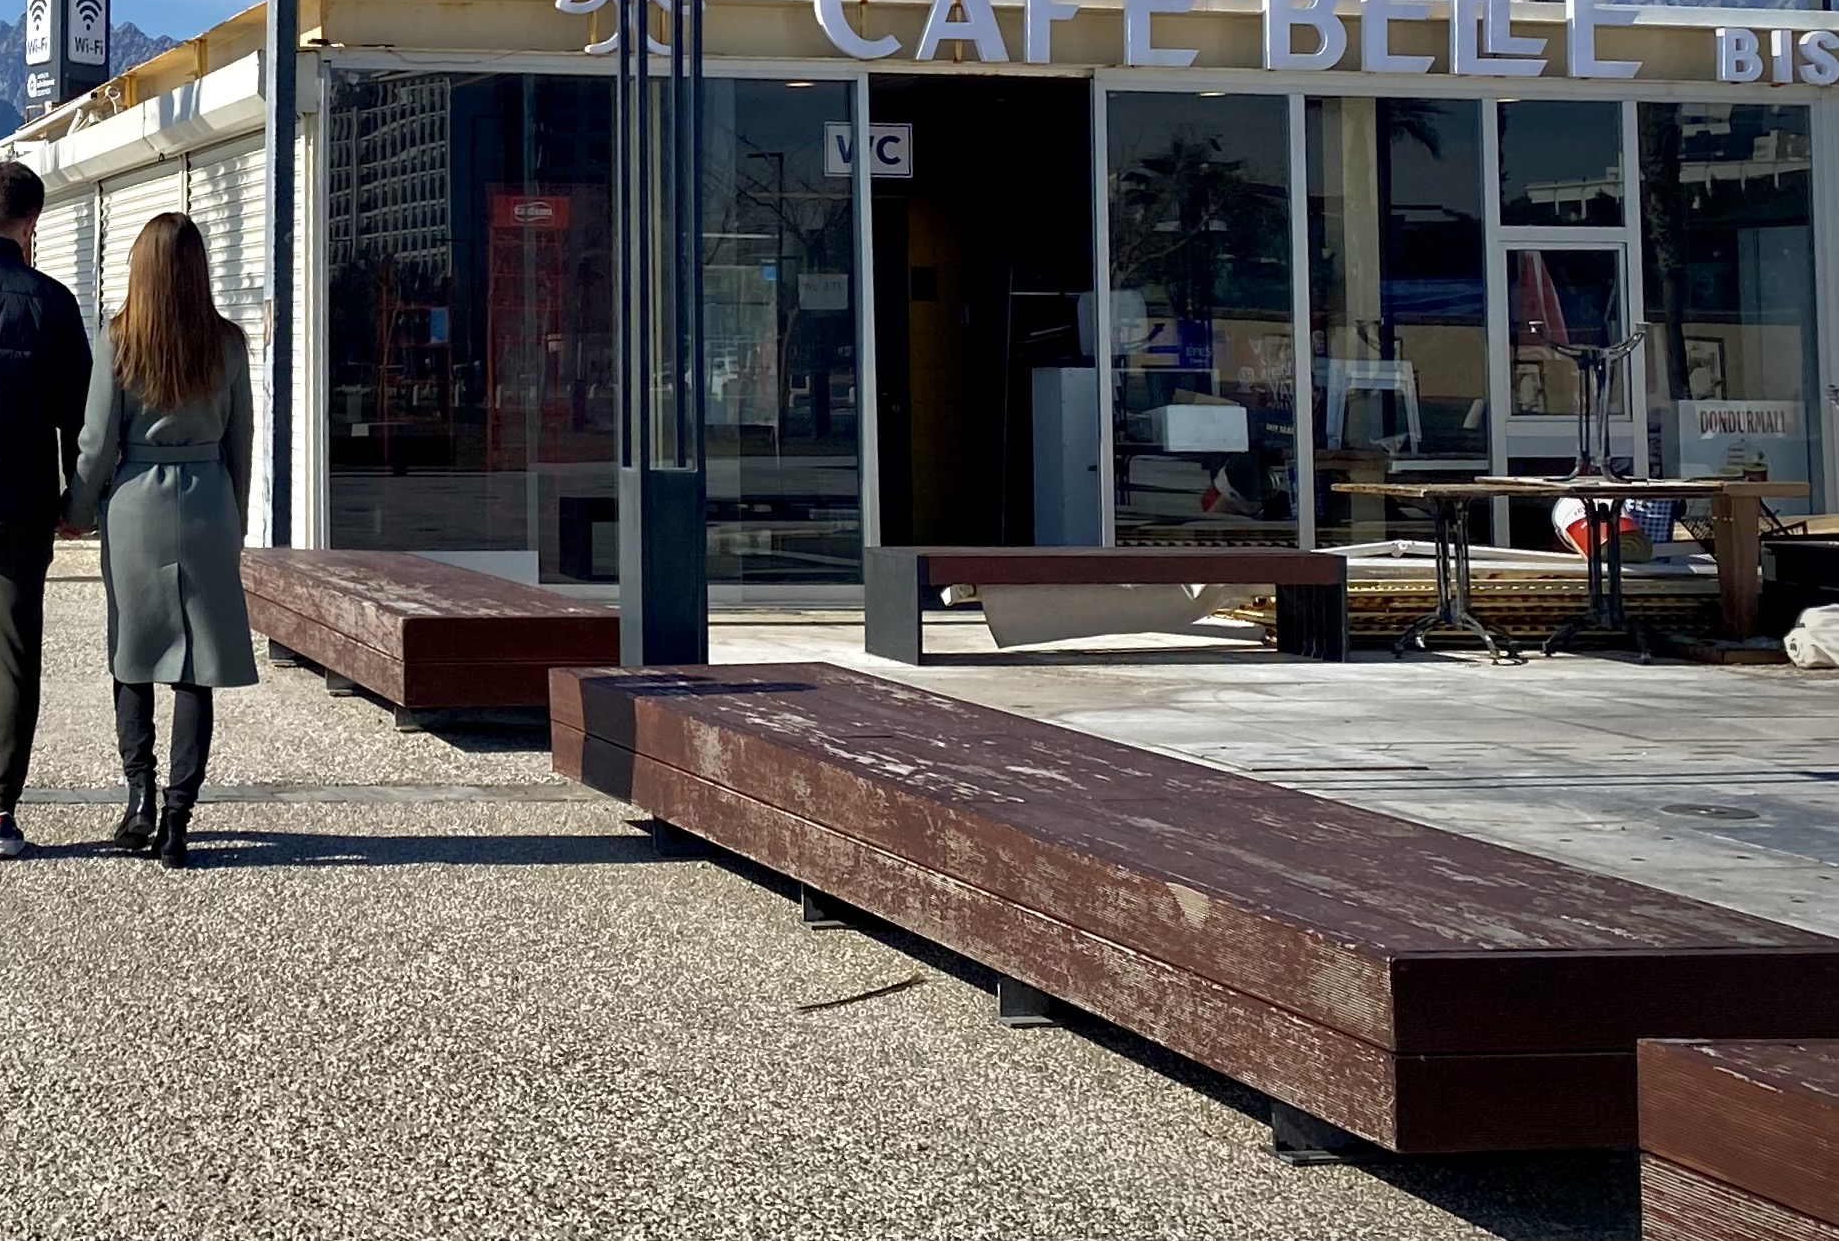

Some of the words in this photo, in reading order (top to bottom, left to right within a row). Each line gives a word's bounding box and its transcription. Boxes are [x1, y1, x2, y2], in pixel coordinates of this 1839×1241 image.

[27, 36, 48, 55] Wi-Fi
[74, 36, 104, 56] Wi-Fi
[1715, 27, 1839, 86] BIS
